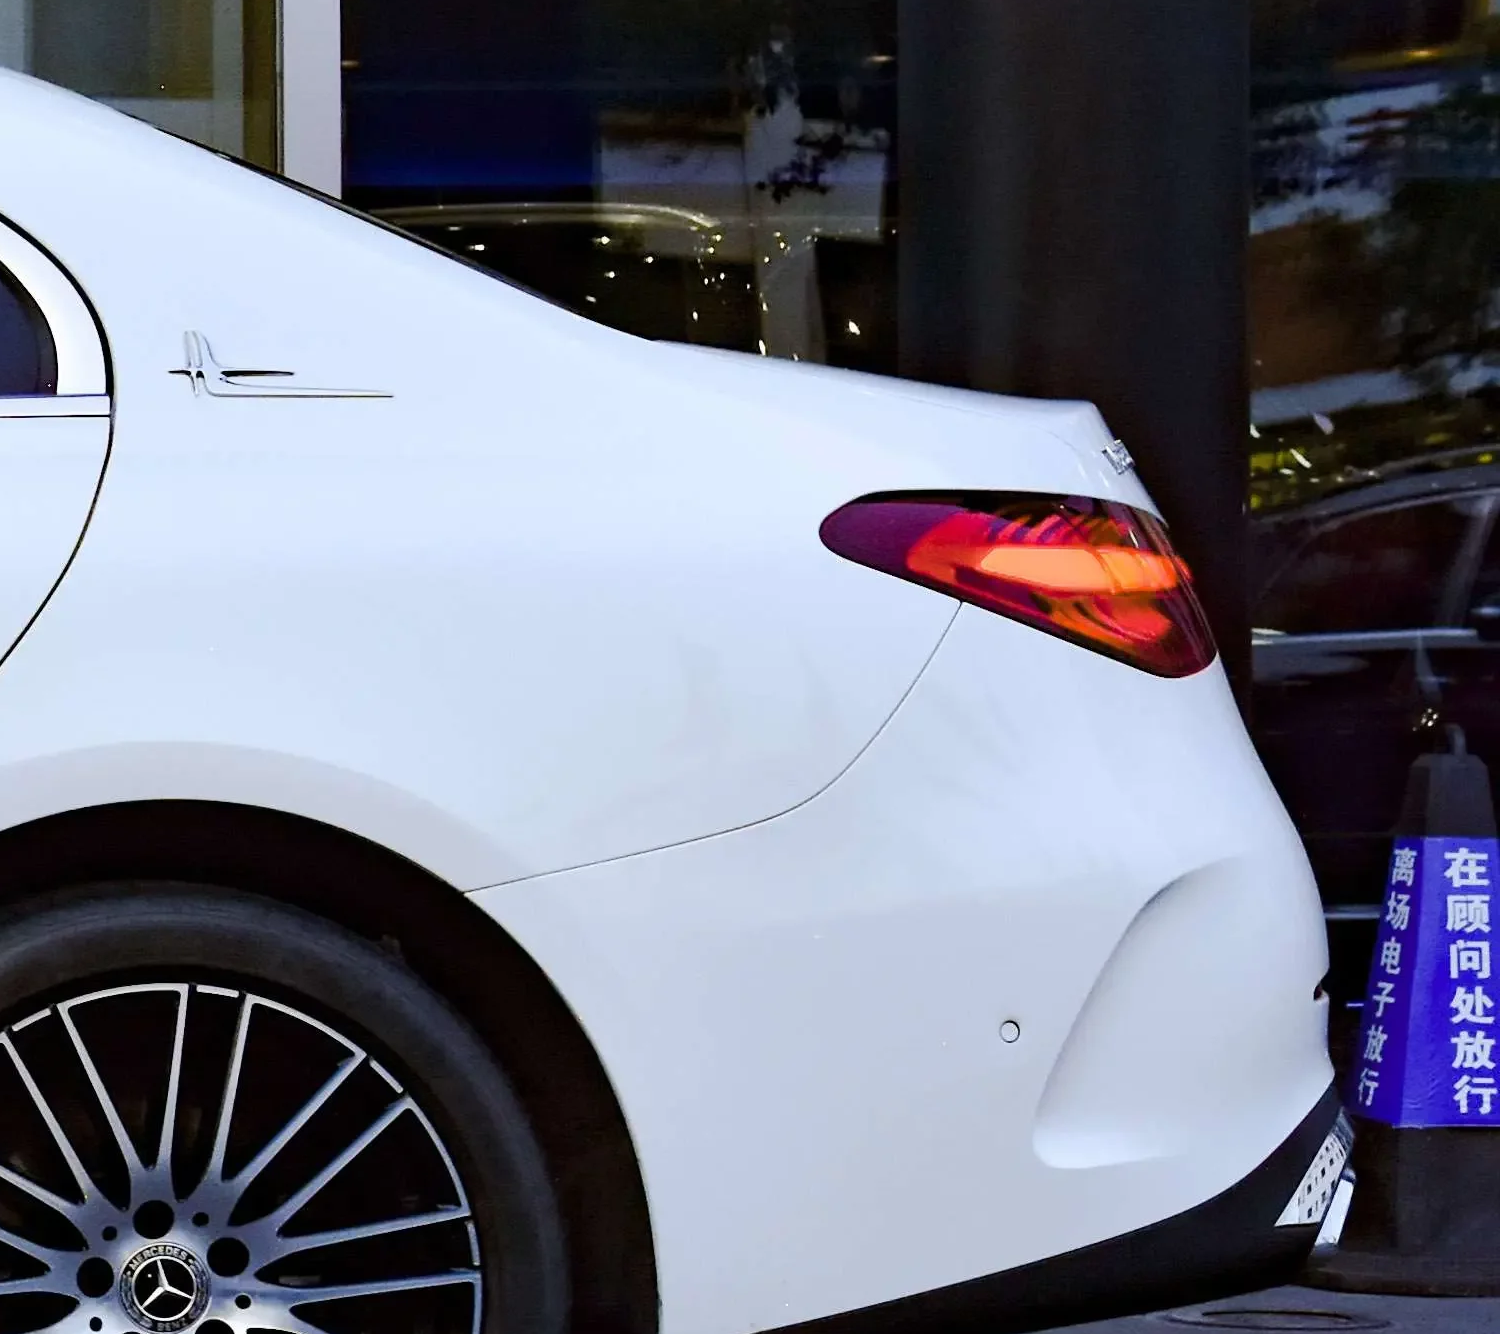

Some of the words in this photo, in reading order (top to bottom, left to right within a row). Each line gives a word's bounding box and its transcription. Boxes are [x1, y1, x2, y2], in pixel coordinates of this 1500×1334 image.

[1357, 846, 1418, 1107] 离场电子放行
[1443, 847, 1498, 1115] 在顾问处放行
[129, 1245, 188, 1271] MERCEDES
